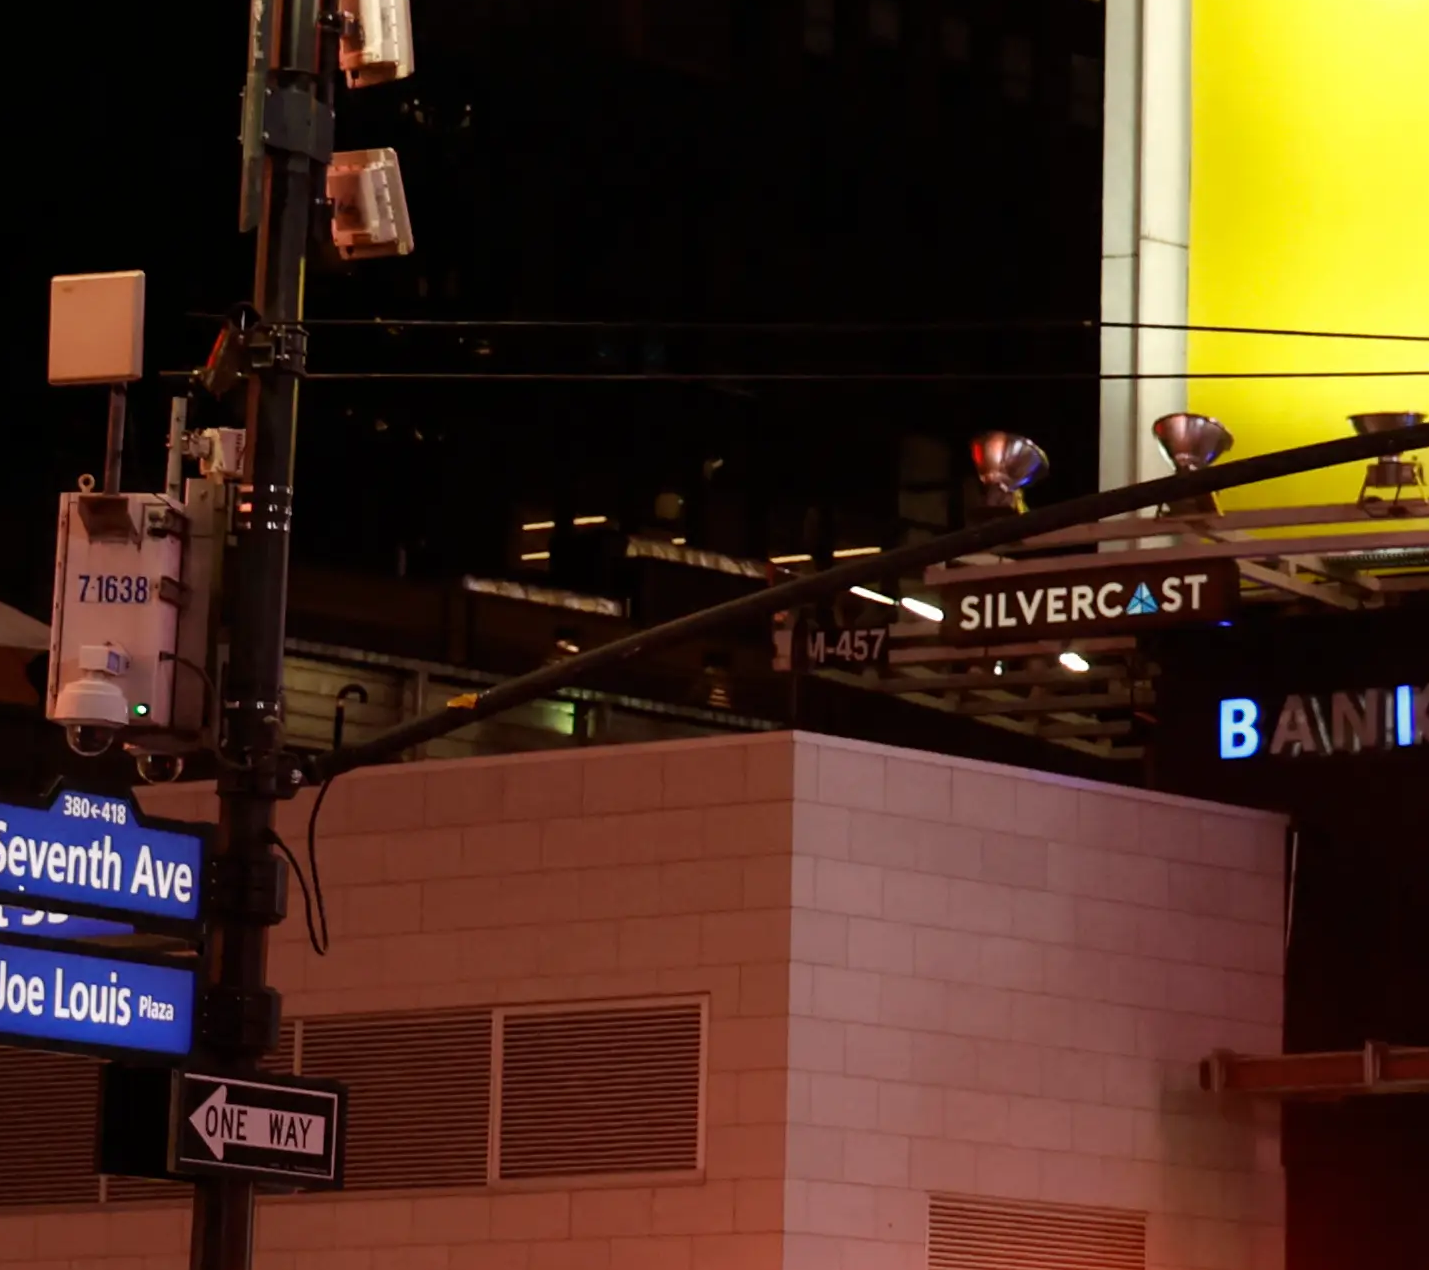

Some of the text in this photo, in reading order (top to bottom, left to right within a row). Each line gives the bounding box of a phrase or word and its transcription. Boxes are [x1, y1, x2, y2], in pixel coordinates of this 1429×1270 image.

[960, 575, 1207, 629] SILVERCAST
[131, 845, 193, 902] Ave
[53, 967, 131, 1026] Louis
[139, 996, 174, 1021] Plaza
[204, 1096, 312, 1149] ONE WAY
